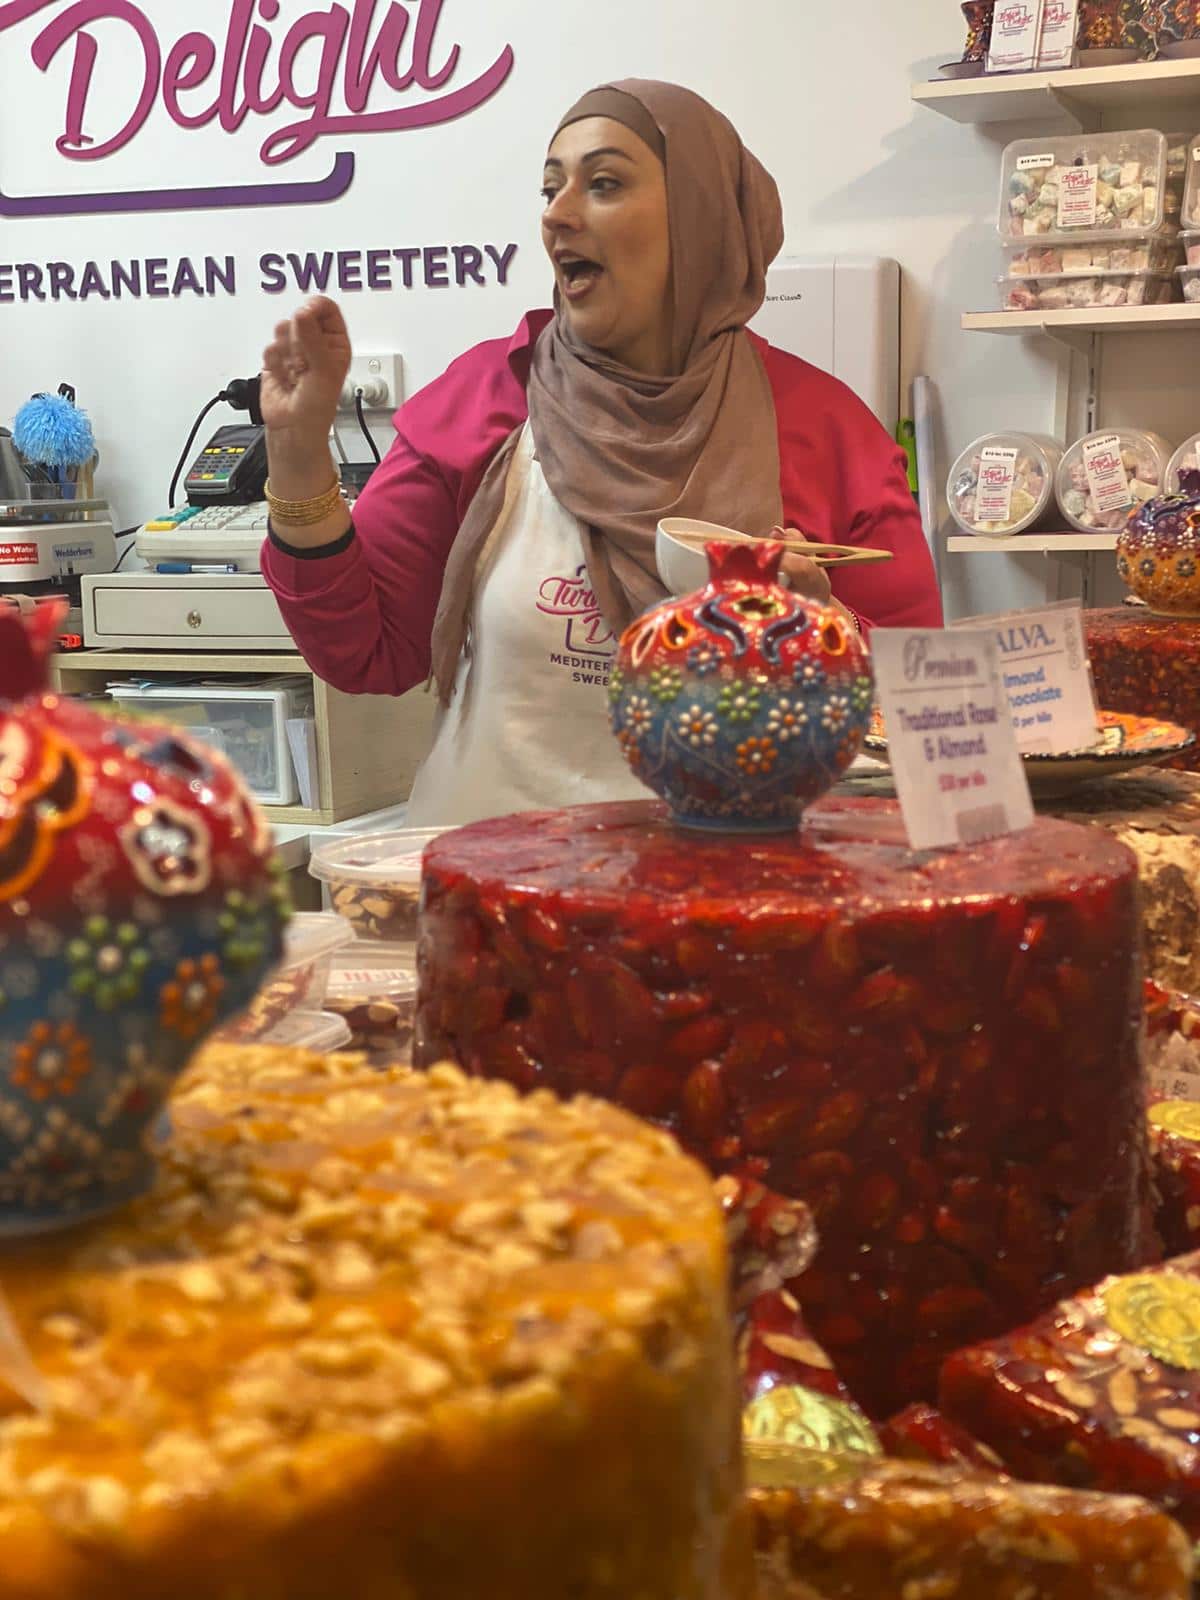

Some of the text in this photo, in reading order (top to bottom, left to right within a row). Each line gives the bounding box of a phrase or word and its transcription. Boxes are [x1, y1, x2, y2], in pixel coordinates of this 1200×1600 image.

[259, 244, 519, 292] SWEETERY
[896, 705, 966, 731] Traditional
[938, 733, 987, 759] Almond
